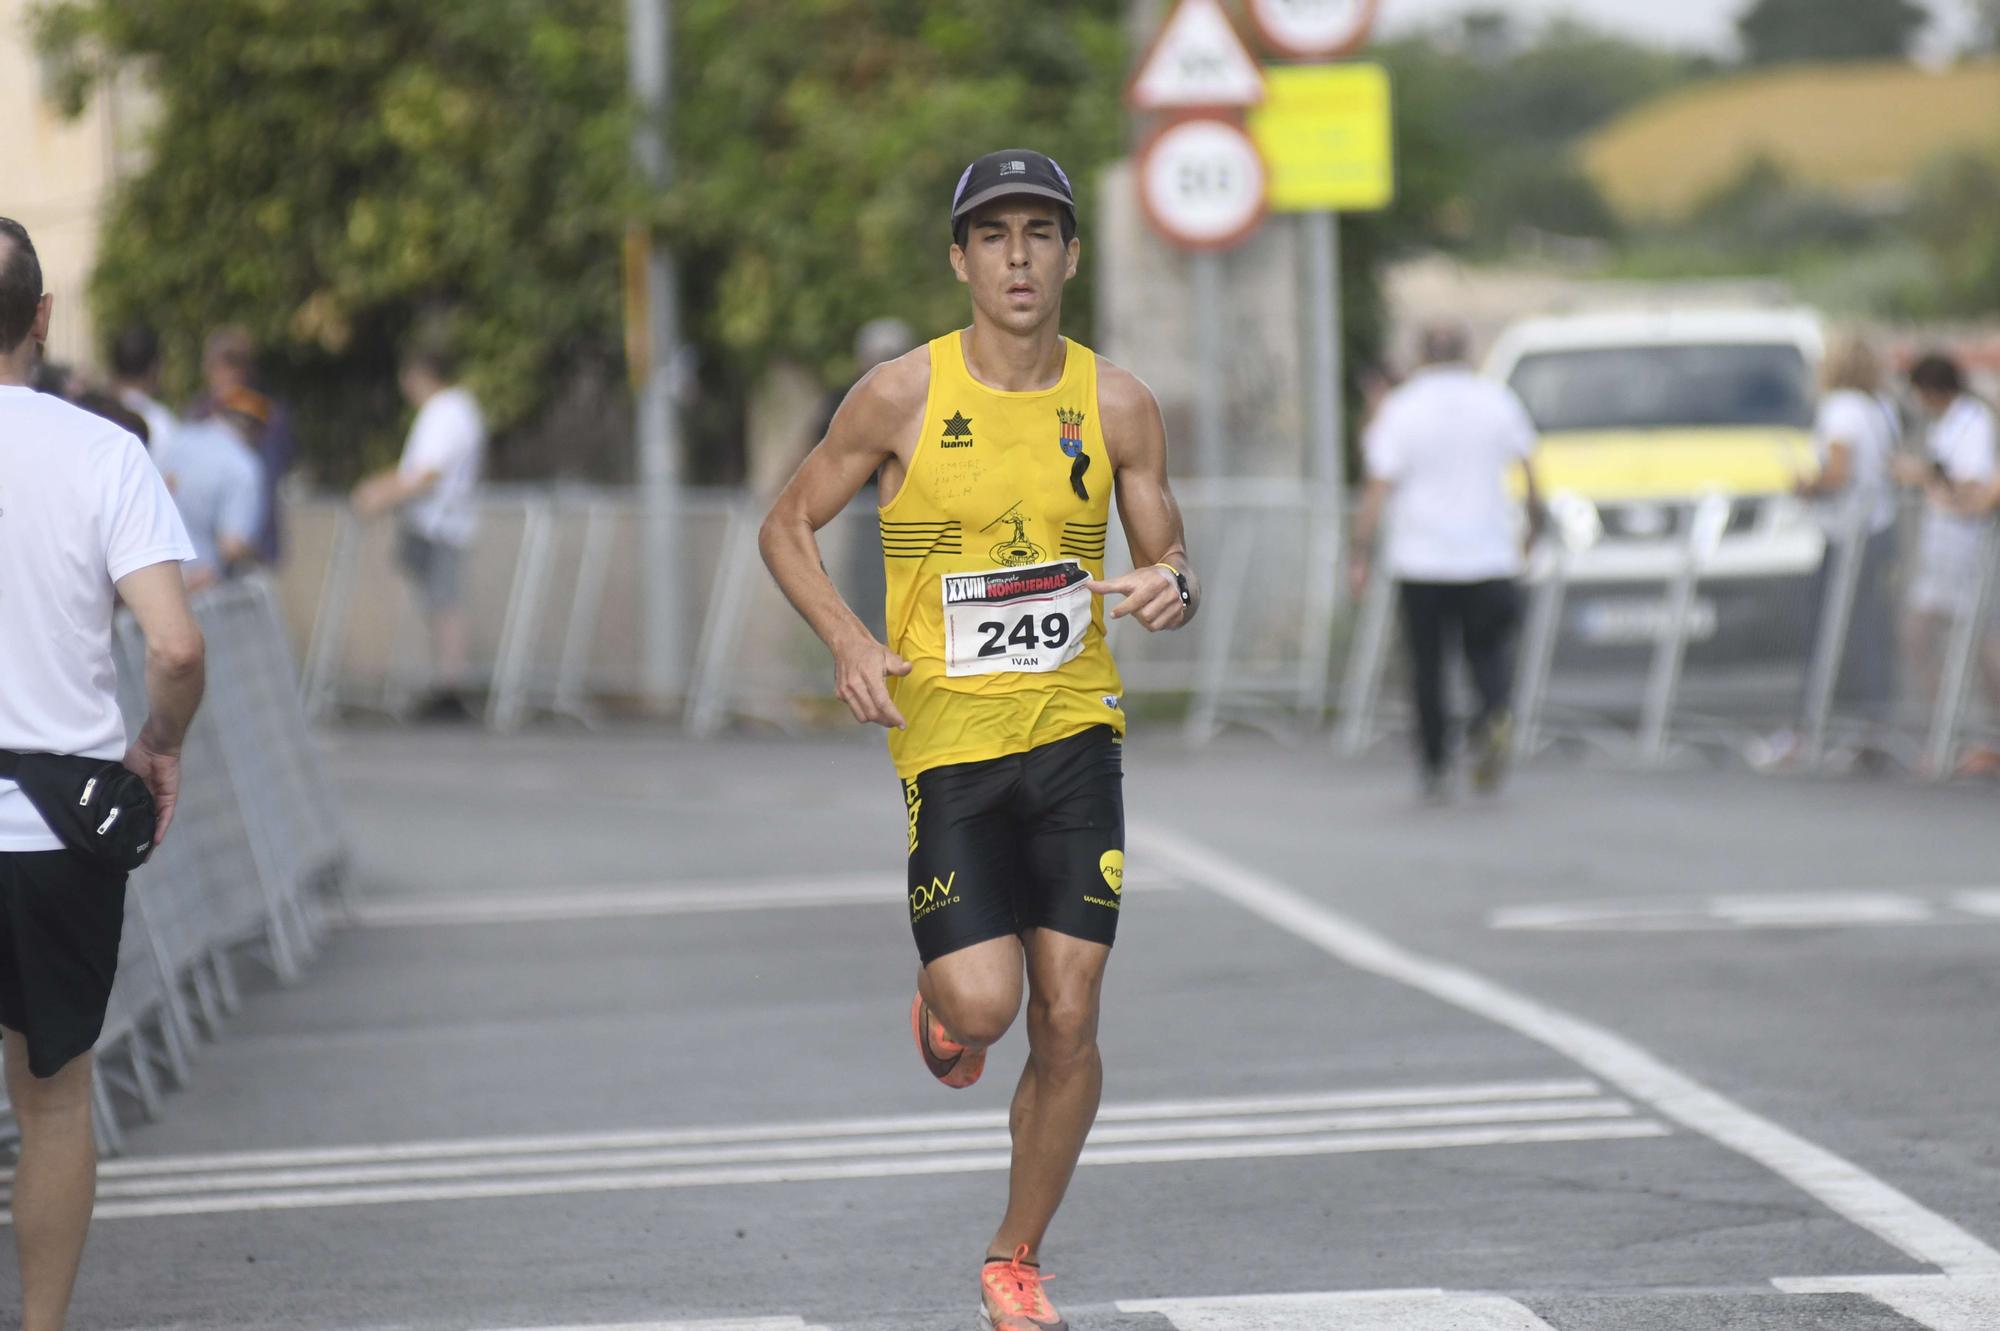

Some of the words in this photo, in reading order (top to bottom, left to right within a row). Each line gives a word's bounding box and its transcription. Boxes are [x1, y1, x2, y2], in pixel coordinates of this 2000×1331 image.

[941, 439, 973, 448] luanvi
[948, 577, 986, 602] XXVIII
[987, 574, 1068, 598] NONDUERMAS
[977, 613, 1070, 657] 249
[1012, 658, 1039, 666] IVAN
